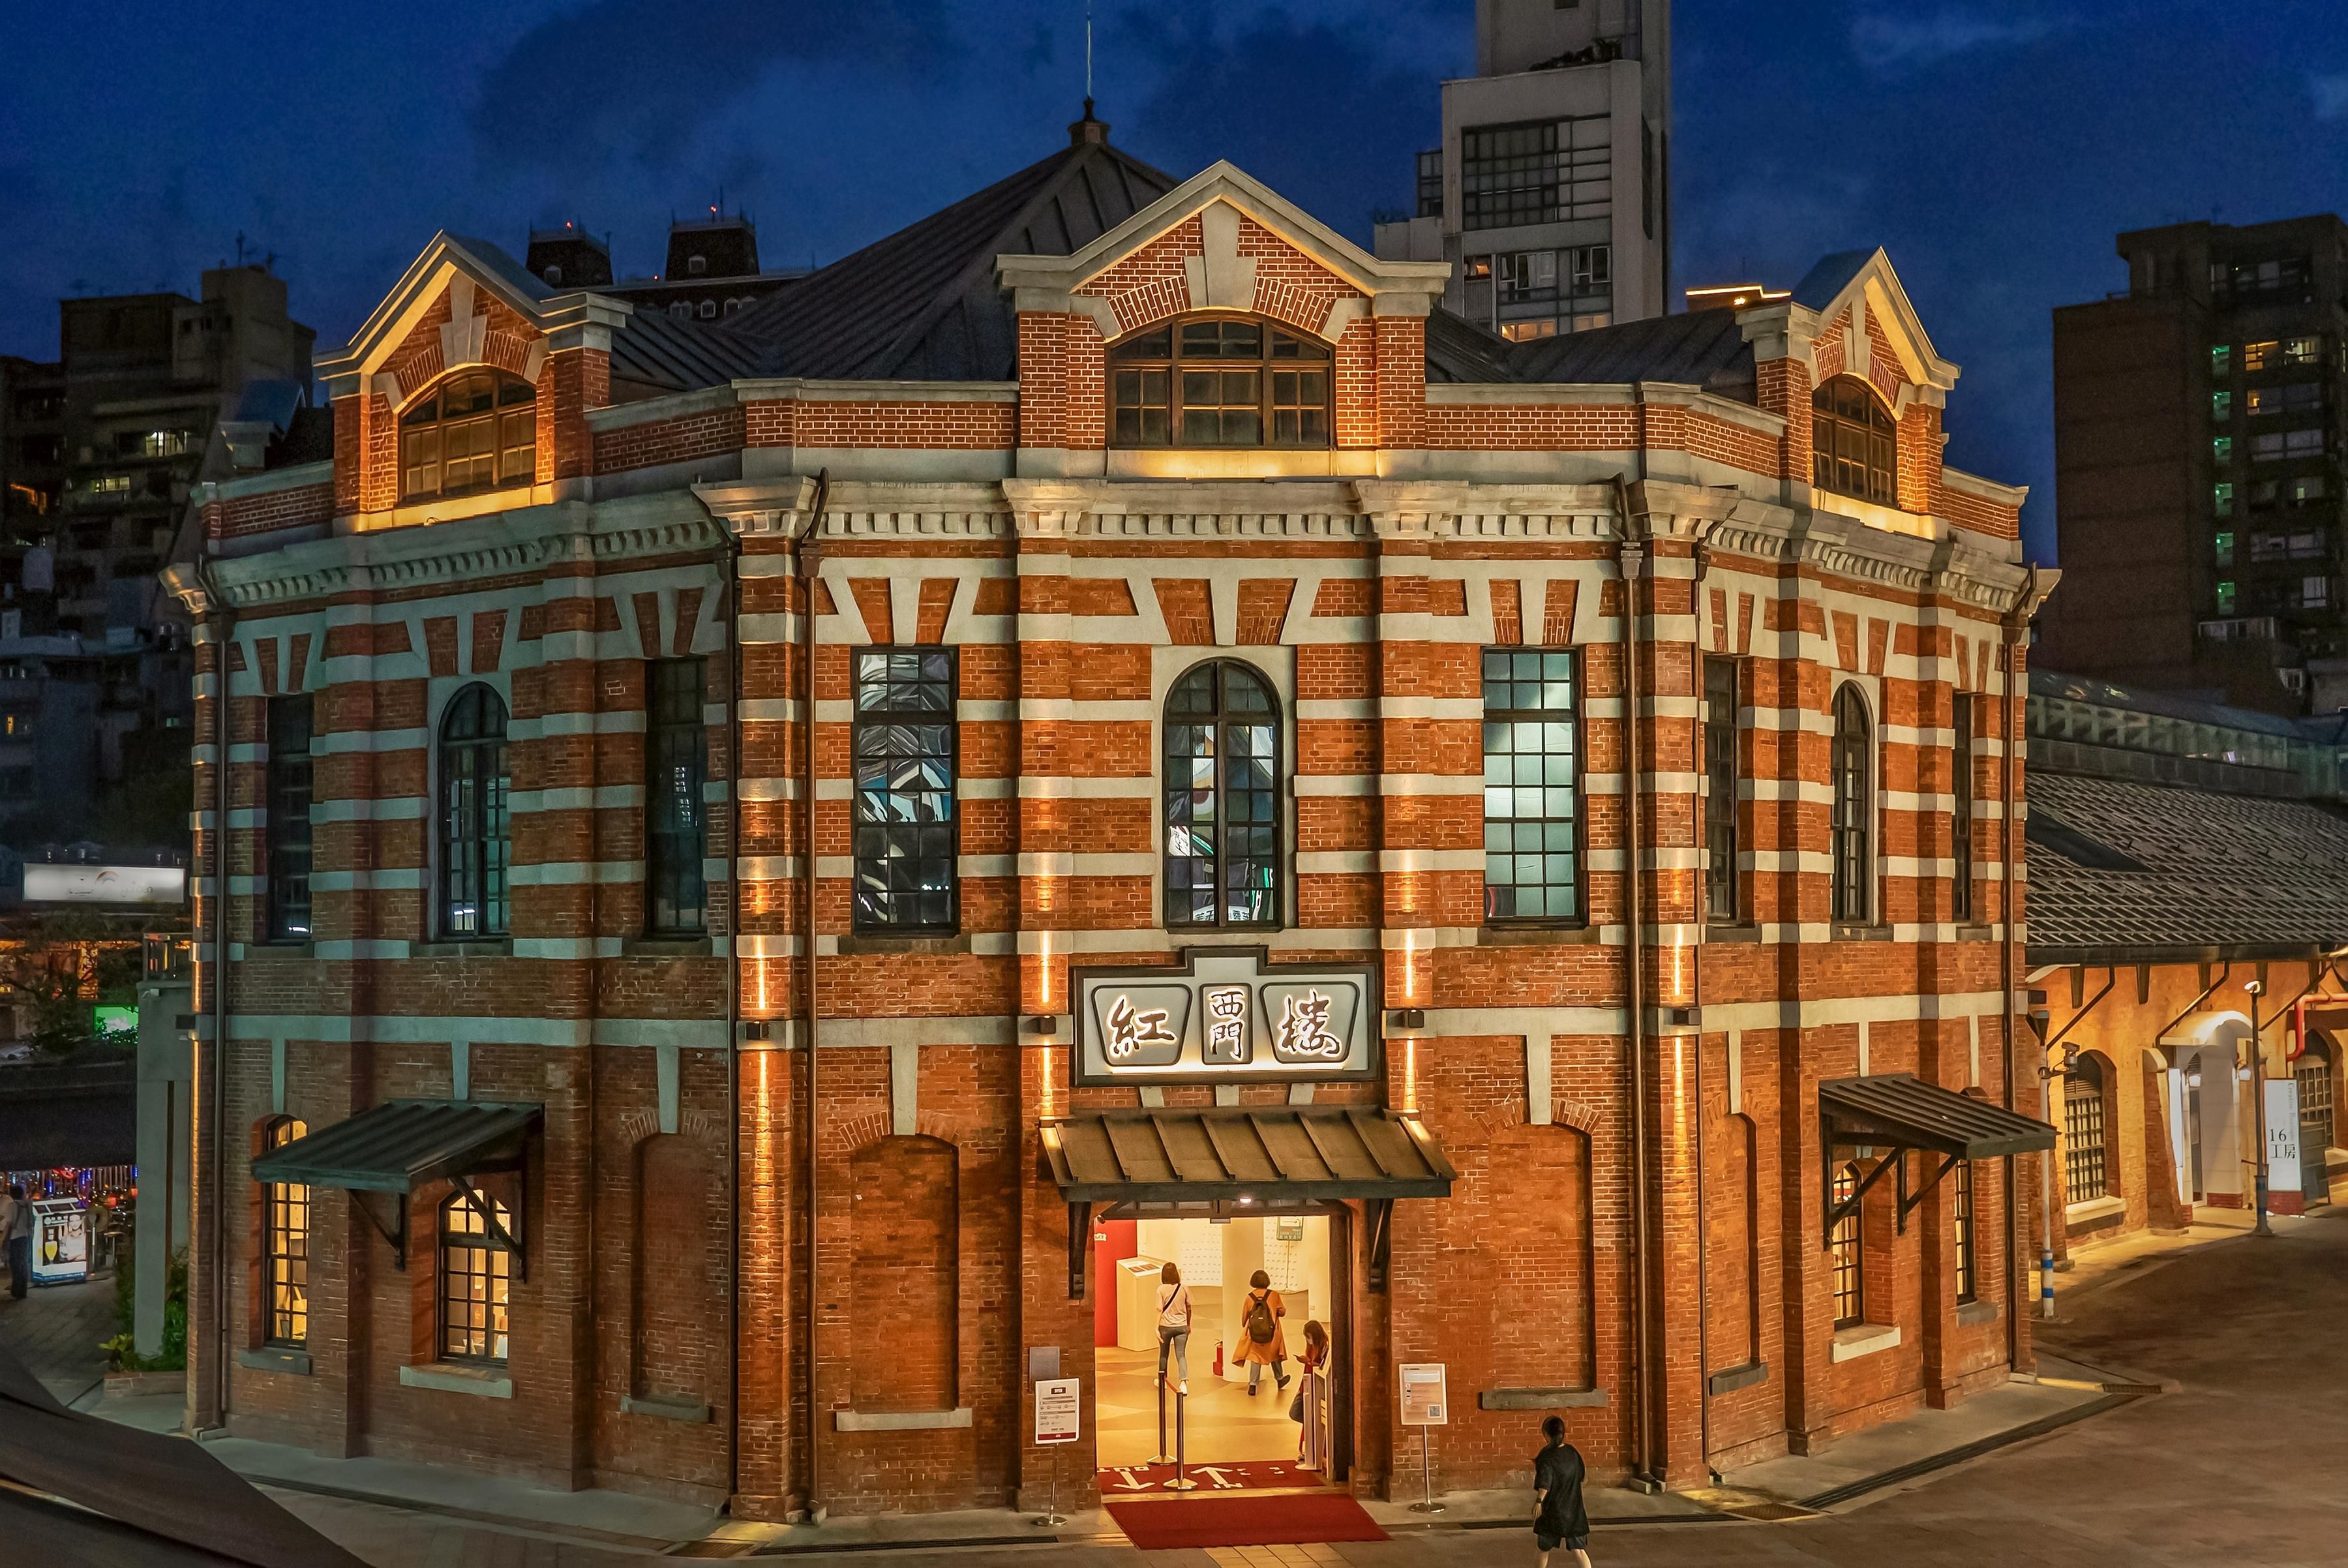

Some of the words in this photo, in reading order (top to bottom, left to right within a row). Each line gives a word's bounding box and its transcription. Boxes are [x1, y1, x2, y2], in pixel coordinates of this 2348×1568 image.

[1109, 995, 1176, 1056] 紅
[1278, 988, 1342, 1057] 樓
[2270, 1128, 2287, 1141] 16
[2270, 1143, 2296, 1159] 工房
